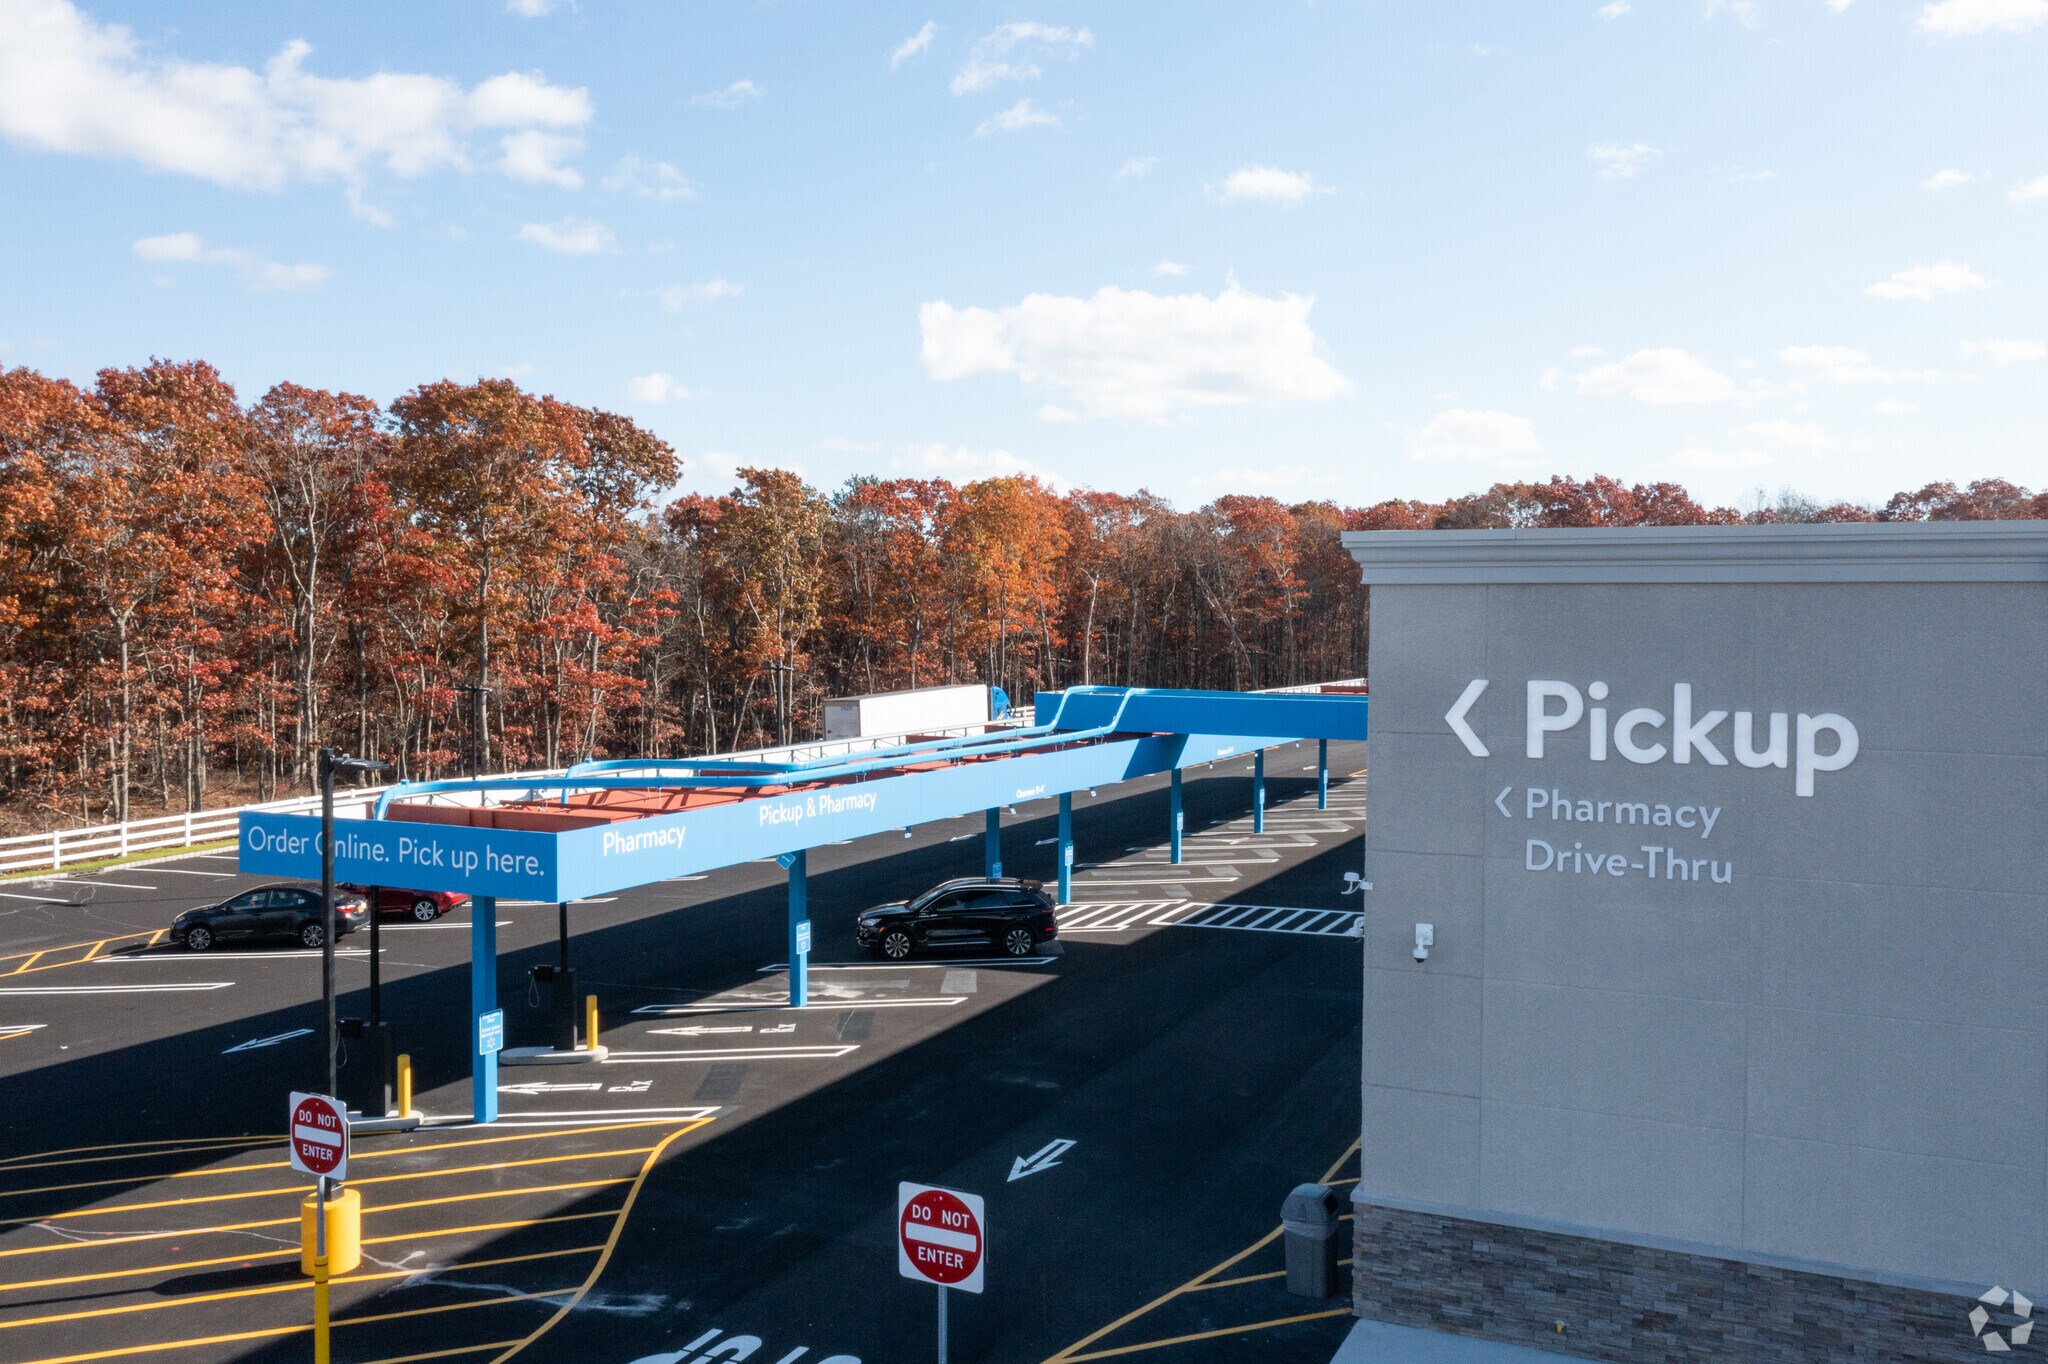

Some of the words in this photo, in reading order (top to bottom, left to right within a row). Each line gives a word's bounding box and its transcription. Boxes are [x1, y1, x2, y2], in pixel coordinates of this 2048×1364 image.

[1526, 680, 1860, 797] Pickup
[759, 804, 803, 827] Pickup
[806, 797, 816, 818] &
[819, 793, 877, 815] Pharmacy
[1526, 788, 1721, 839] Pharmacy
[248, 826, 309, 855] Order
[398, 837, 444, 867] Pick
[451, 849, 478, 877] up
[486, 844, 545, 876] here.
[603, 826, 686, 857] Pharmacy
[1525, 839, 1734, 884] Drive-Thru
[298, 1109, 312, 1124] DO
[317, 1114, 337, 1129] NOT
[302, 1143, 334, 1163] ENTER
[911, 1204, 931, 1222] DO
[941, 1210, 970, 1229] NOT
[917, 1246, 964, 1270] ENTER
